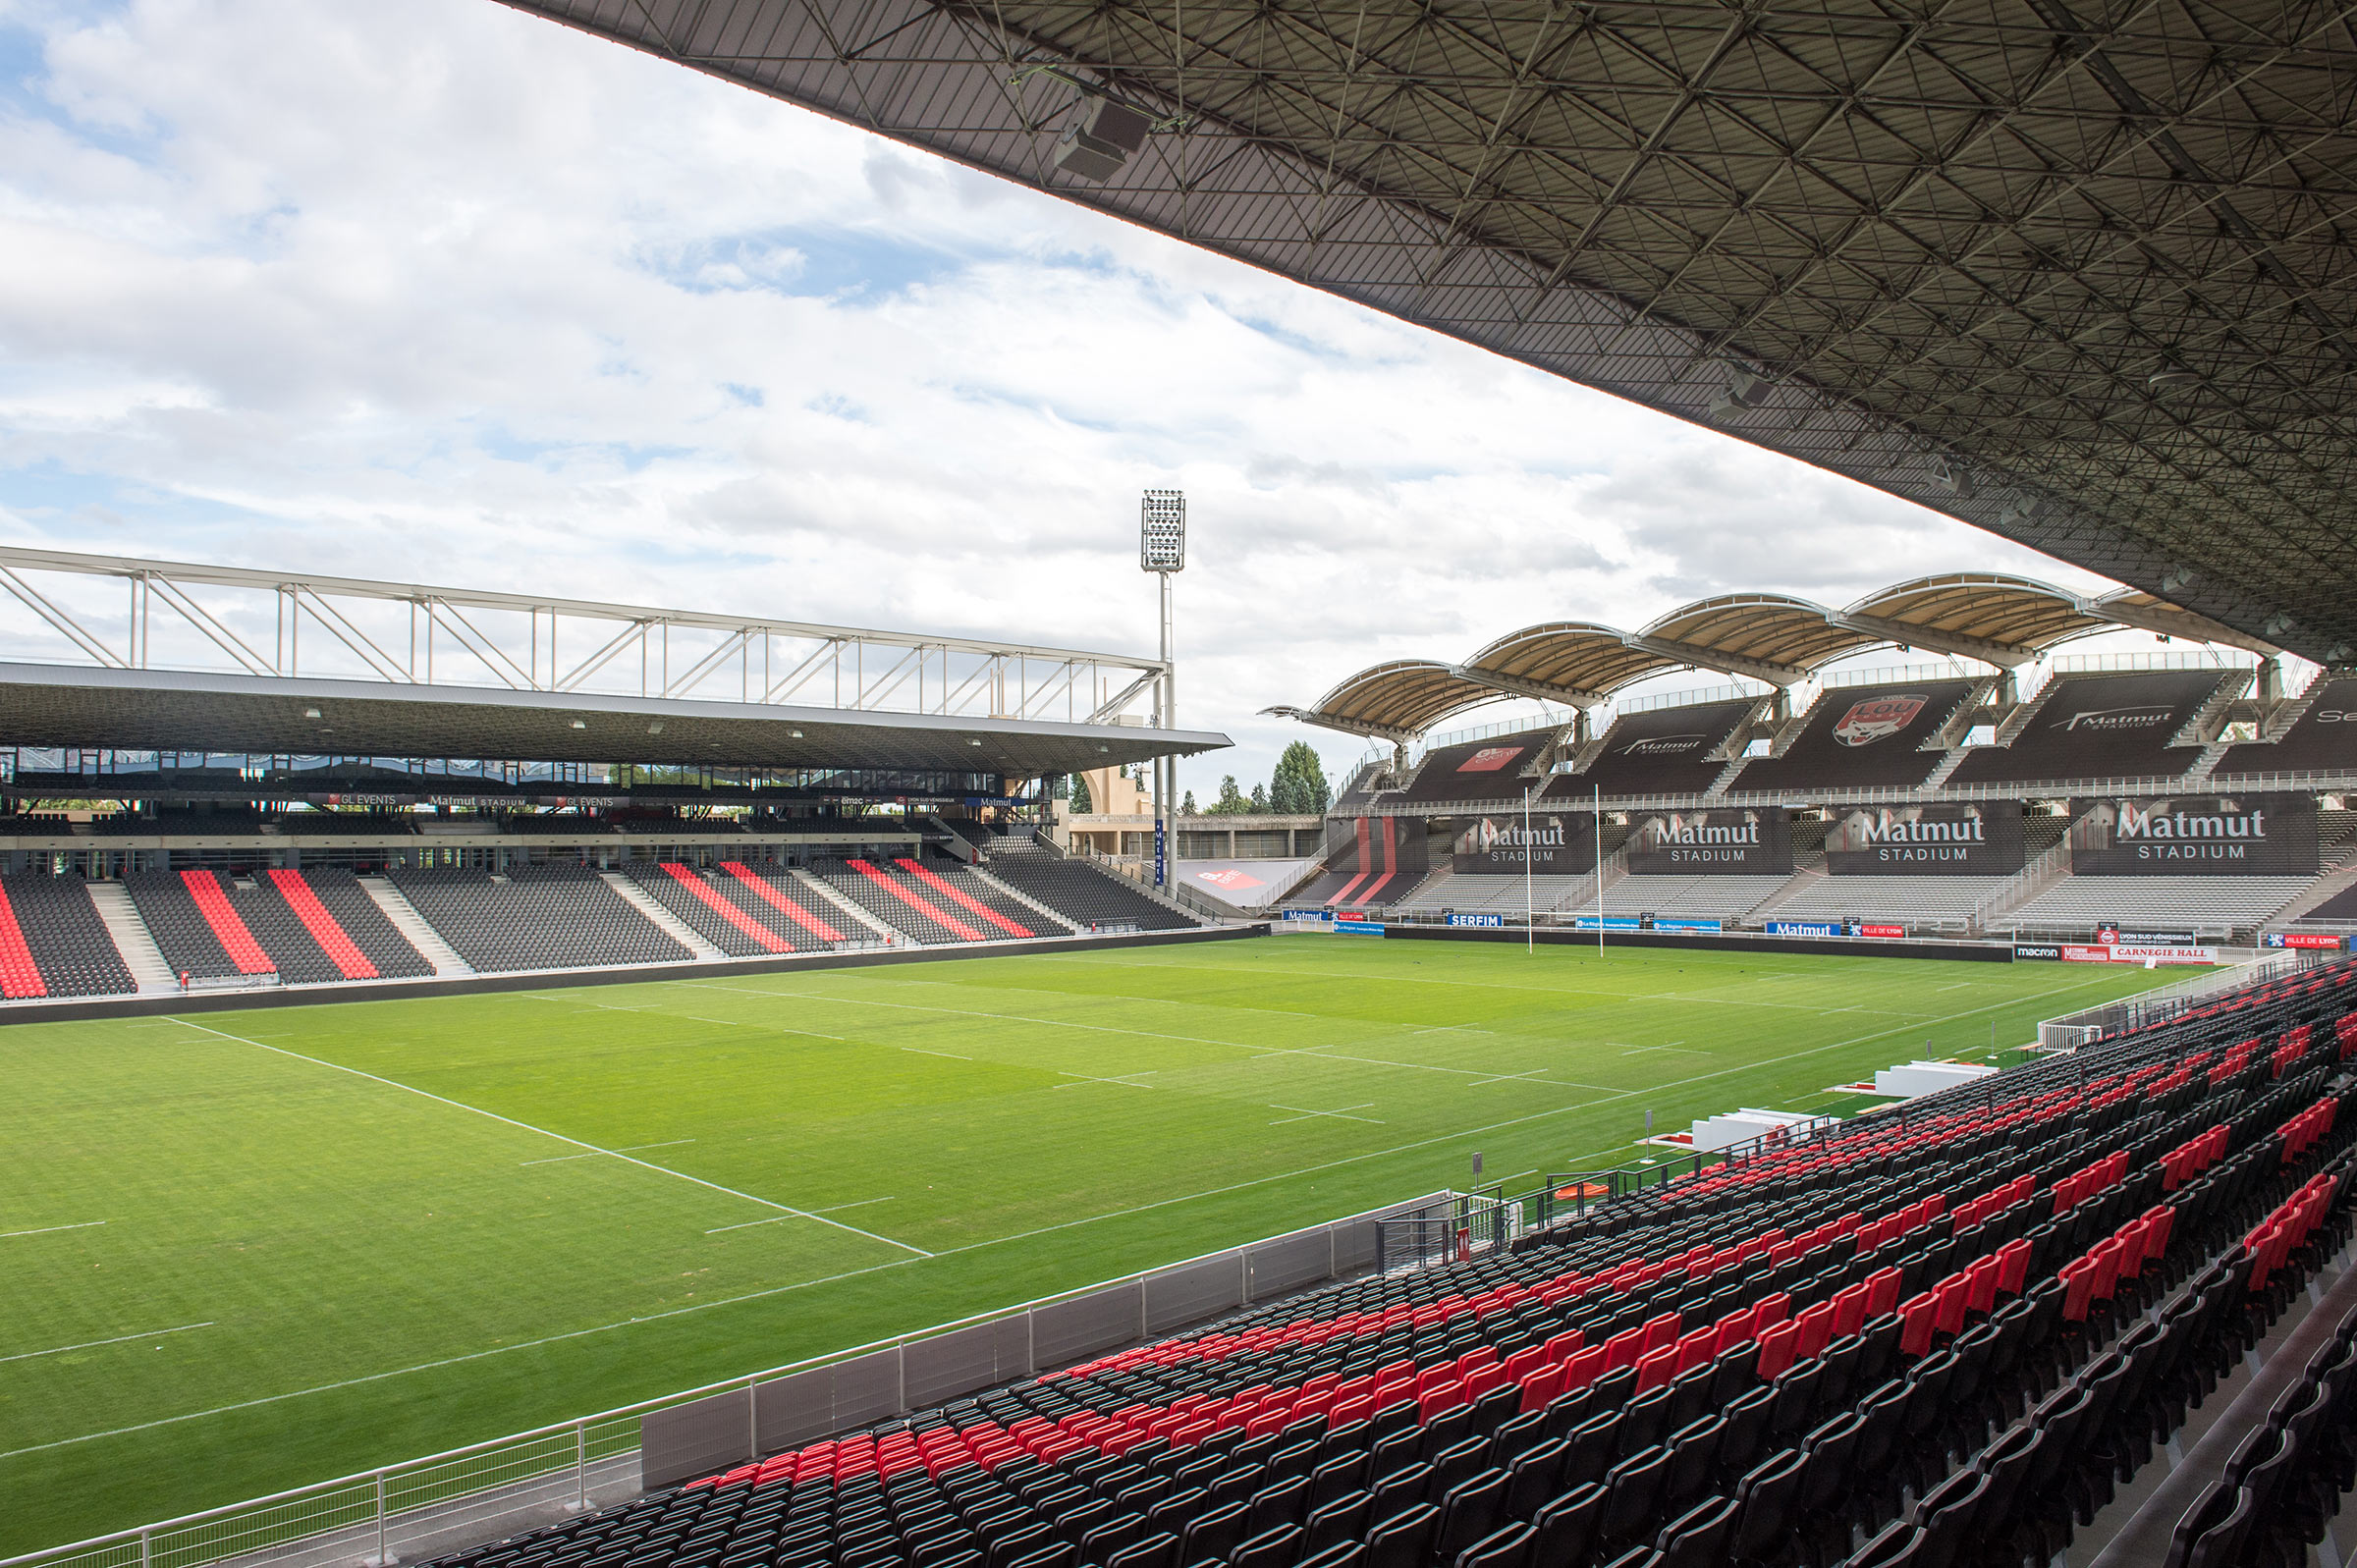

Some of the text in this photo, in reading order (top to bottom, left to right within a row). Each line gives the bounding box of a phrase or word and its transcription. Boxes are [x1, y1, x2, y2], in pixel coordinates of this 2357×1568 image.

[1855, 701, 1917, 716] LOU
[2082, 713, 2172, 726] Matmut
[2092, 722, 2156, 730] STADIUM
[1636, 740, 1701, 751] Matmut
[1476, 748, 1504, 758] GL
[341, 794, 396, 805] GL EVENTS
[430, 795, 476, 806] Matmut
[567, 797, 614, 807] GL EVENTS
[981, 798, 1012, 807] Matmut
[1861, 815, 1986, 842] Matmut
[2116, 810, 2267, 838] Matmut
[1478, 824, 1565, 846] Matmut
[1656, 821, 1760, 844] Matmut
[1491, 850, 1554, 862] STADUM
[1671, 849, 1745, 862] STADIUM
[1879, 847, 1967, 861] STADIUM
[2138, 844, 2245, 859] STADIUM
[1288, 910, 1322, 921] Matmut
[1452, 915, 1498, 926] SERFIM
[1777, 923, 1832, 936] Matmut
[2017, 947, 2058, 957] macron
[2116, 947, 2174, 956] CARNEGIE
